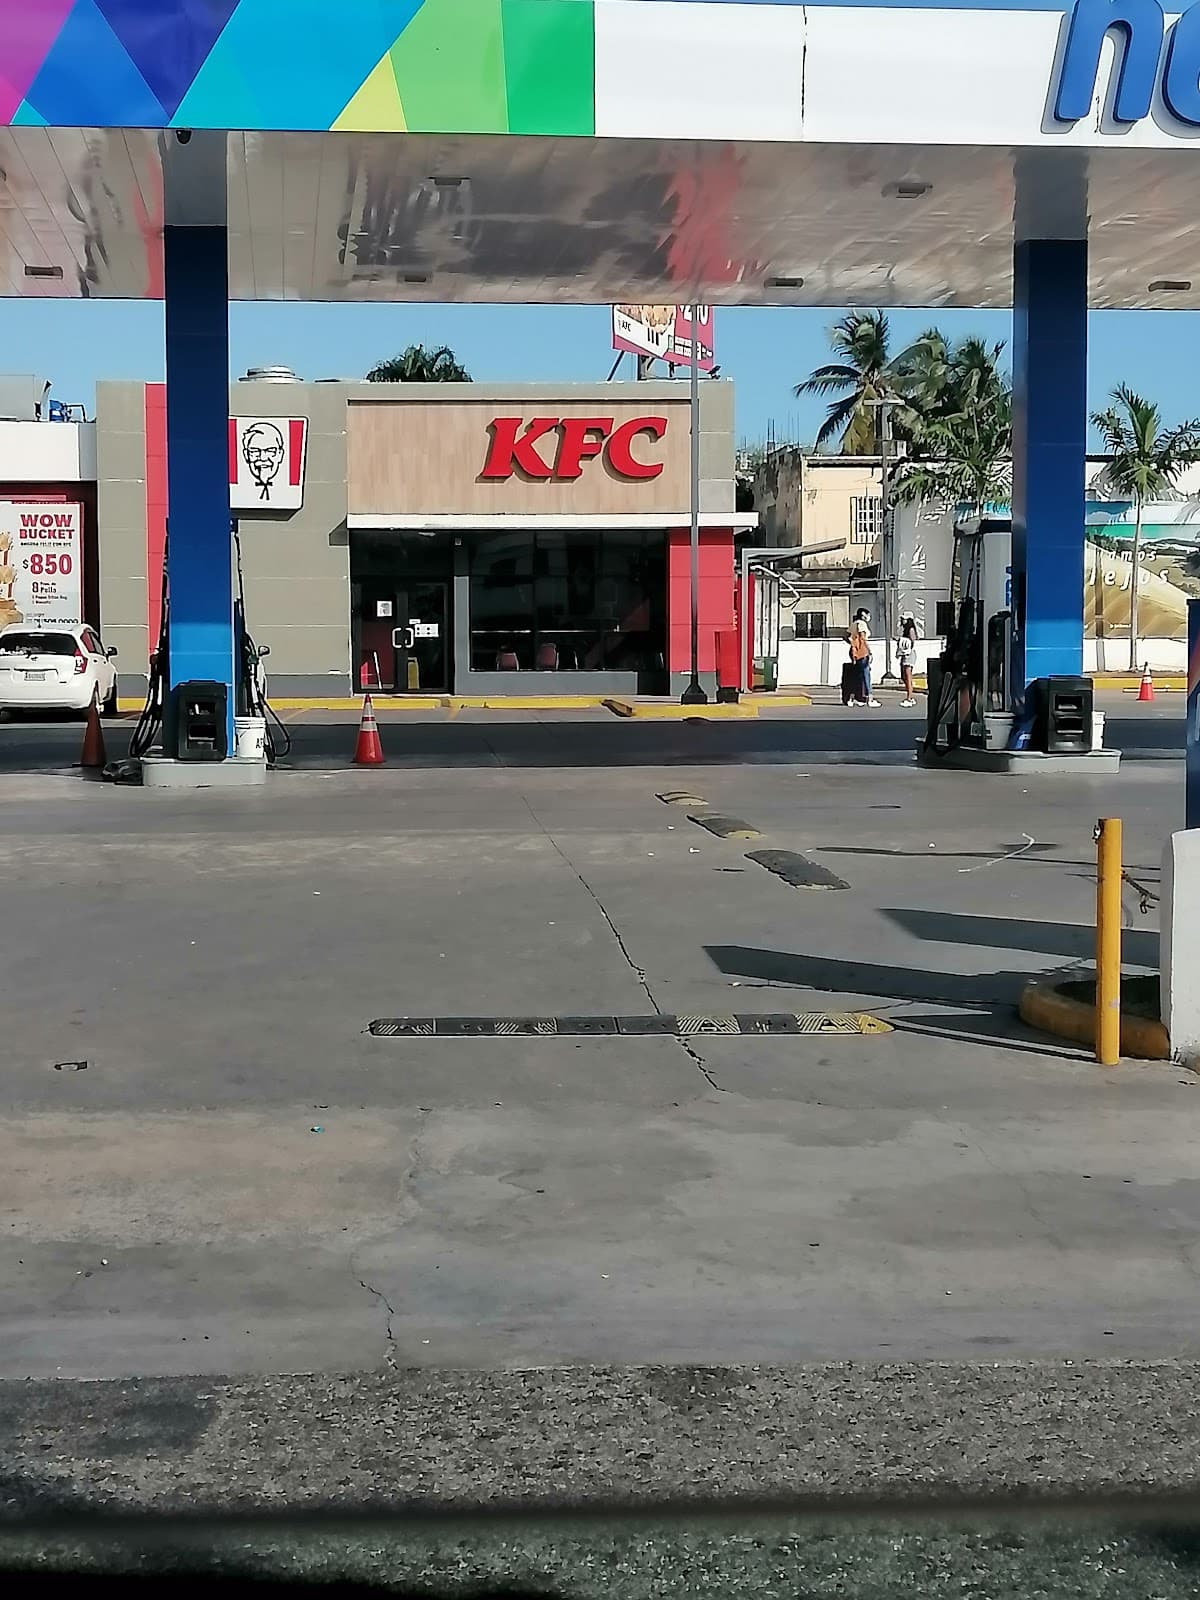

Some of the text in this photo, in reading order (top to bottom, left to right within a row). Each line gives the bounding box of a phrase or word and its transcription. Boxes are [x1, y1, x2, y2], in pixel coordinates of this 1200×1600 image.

[481, 416, 668, 479] KFC
[20, 514, 73, 527] WOW
[19, 529, 75, 539] BUCKET
[22, 553, 73, 575] $850
